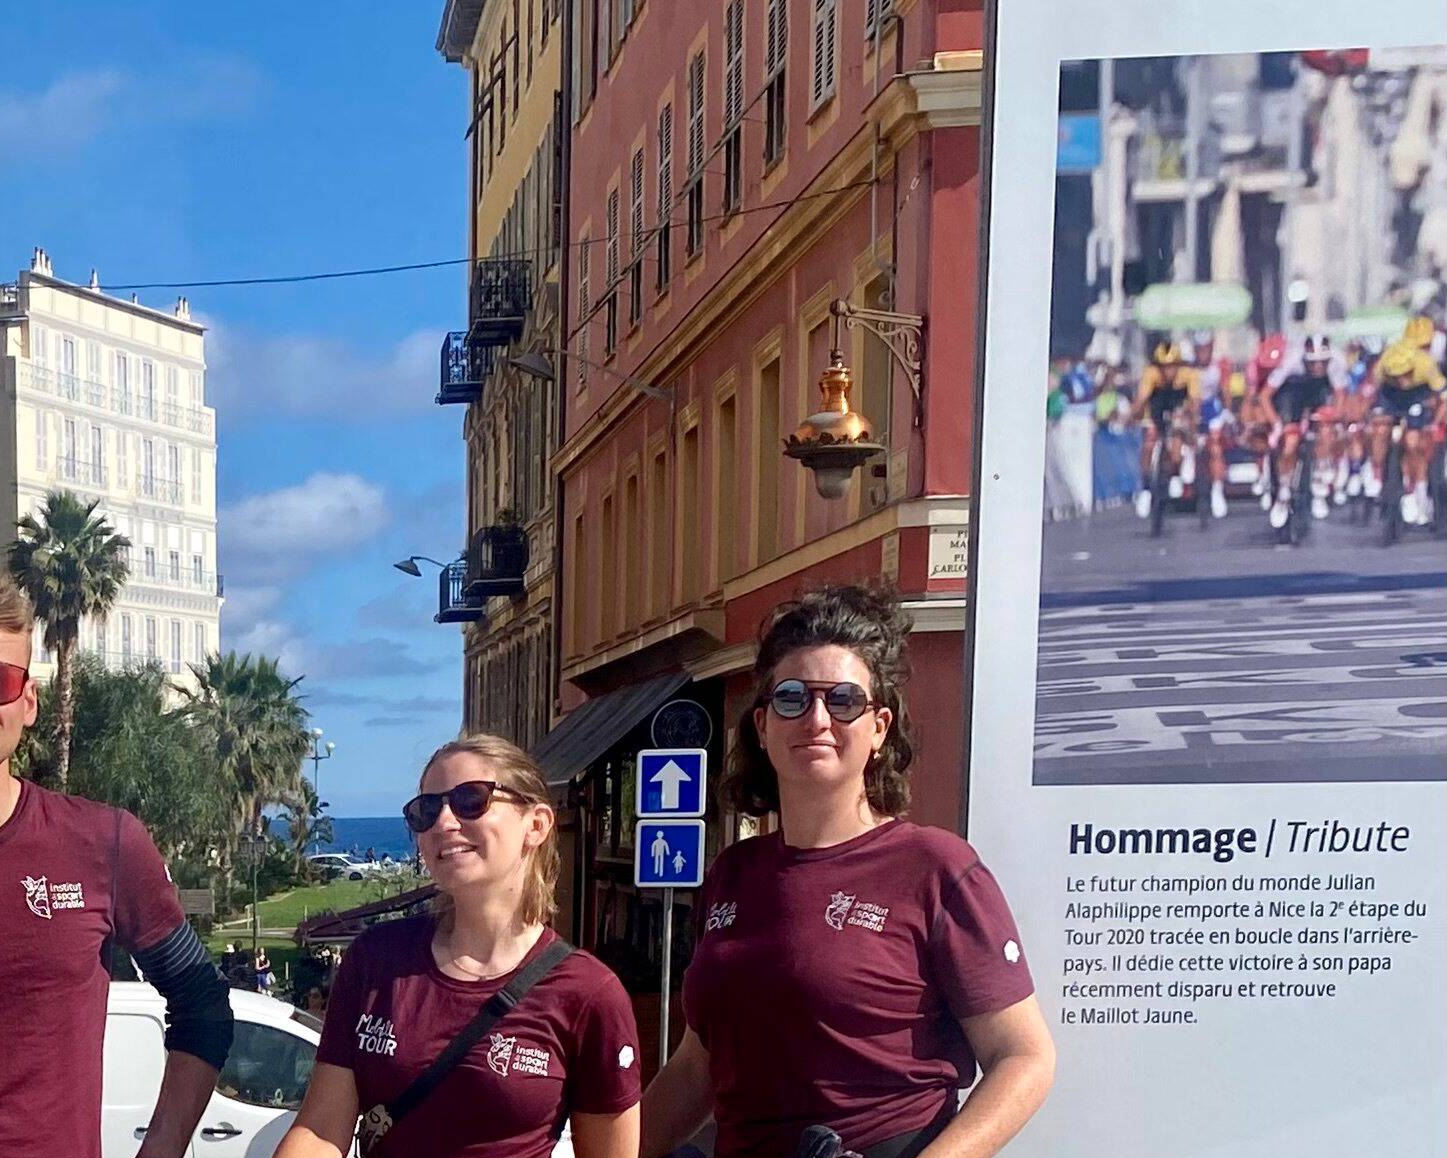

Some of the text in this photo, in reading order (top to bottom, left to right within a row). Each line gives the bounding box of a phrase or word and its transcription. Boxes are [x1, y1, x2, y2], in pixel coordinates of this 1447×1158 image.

[933, 564, 967, 574] CARLO
[1069, 822, 1257, 863] Hommage
[1286, 819, 1411, 853] Tribute
[1066, 873, 1375, 896] Le futur champion du monde Julian
[1065, 901, 1162, 923] Alaphilippe
[1166, 903, 1249, 923] remporte
[1254, 901, 1264, 917] à
[1269, 900, 1305, 918] Nice
[1310, 900, 1325, 917] la
[1348, 900, 1399, 921] étape
[1404, 899, 1427, 917] du
[1065, 927, 1418, 945] Tour 2020 tracée en boucle dans l'arrière-
[1063, 954, 1392, 976] pays. Il dédie cette victoire à son papa
[1062, 980, 1336, 1002] récemment disparu et retrouve
[1061, 1007, 1198, 1024] le Maillot Jaune.
[358, 1033, 398, 1056] TOUR
